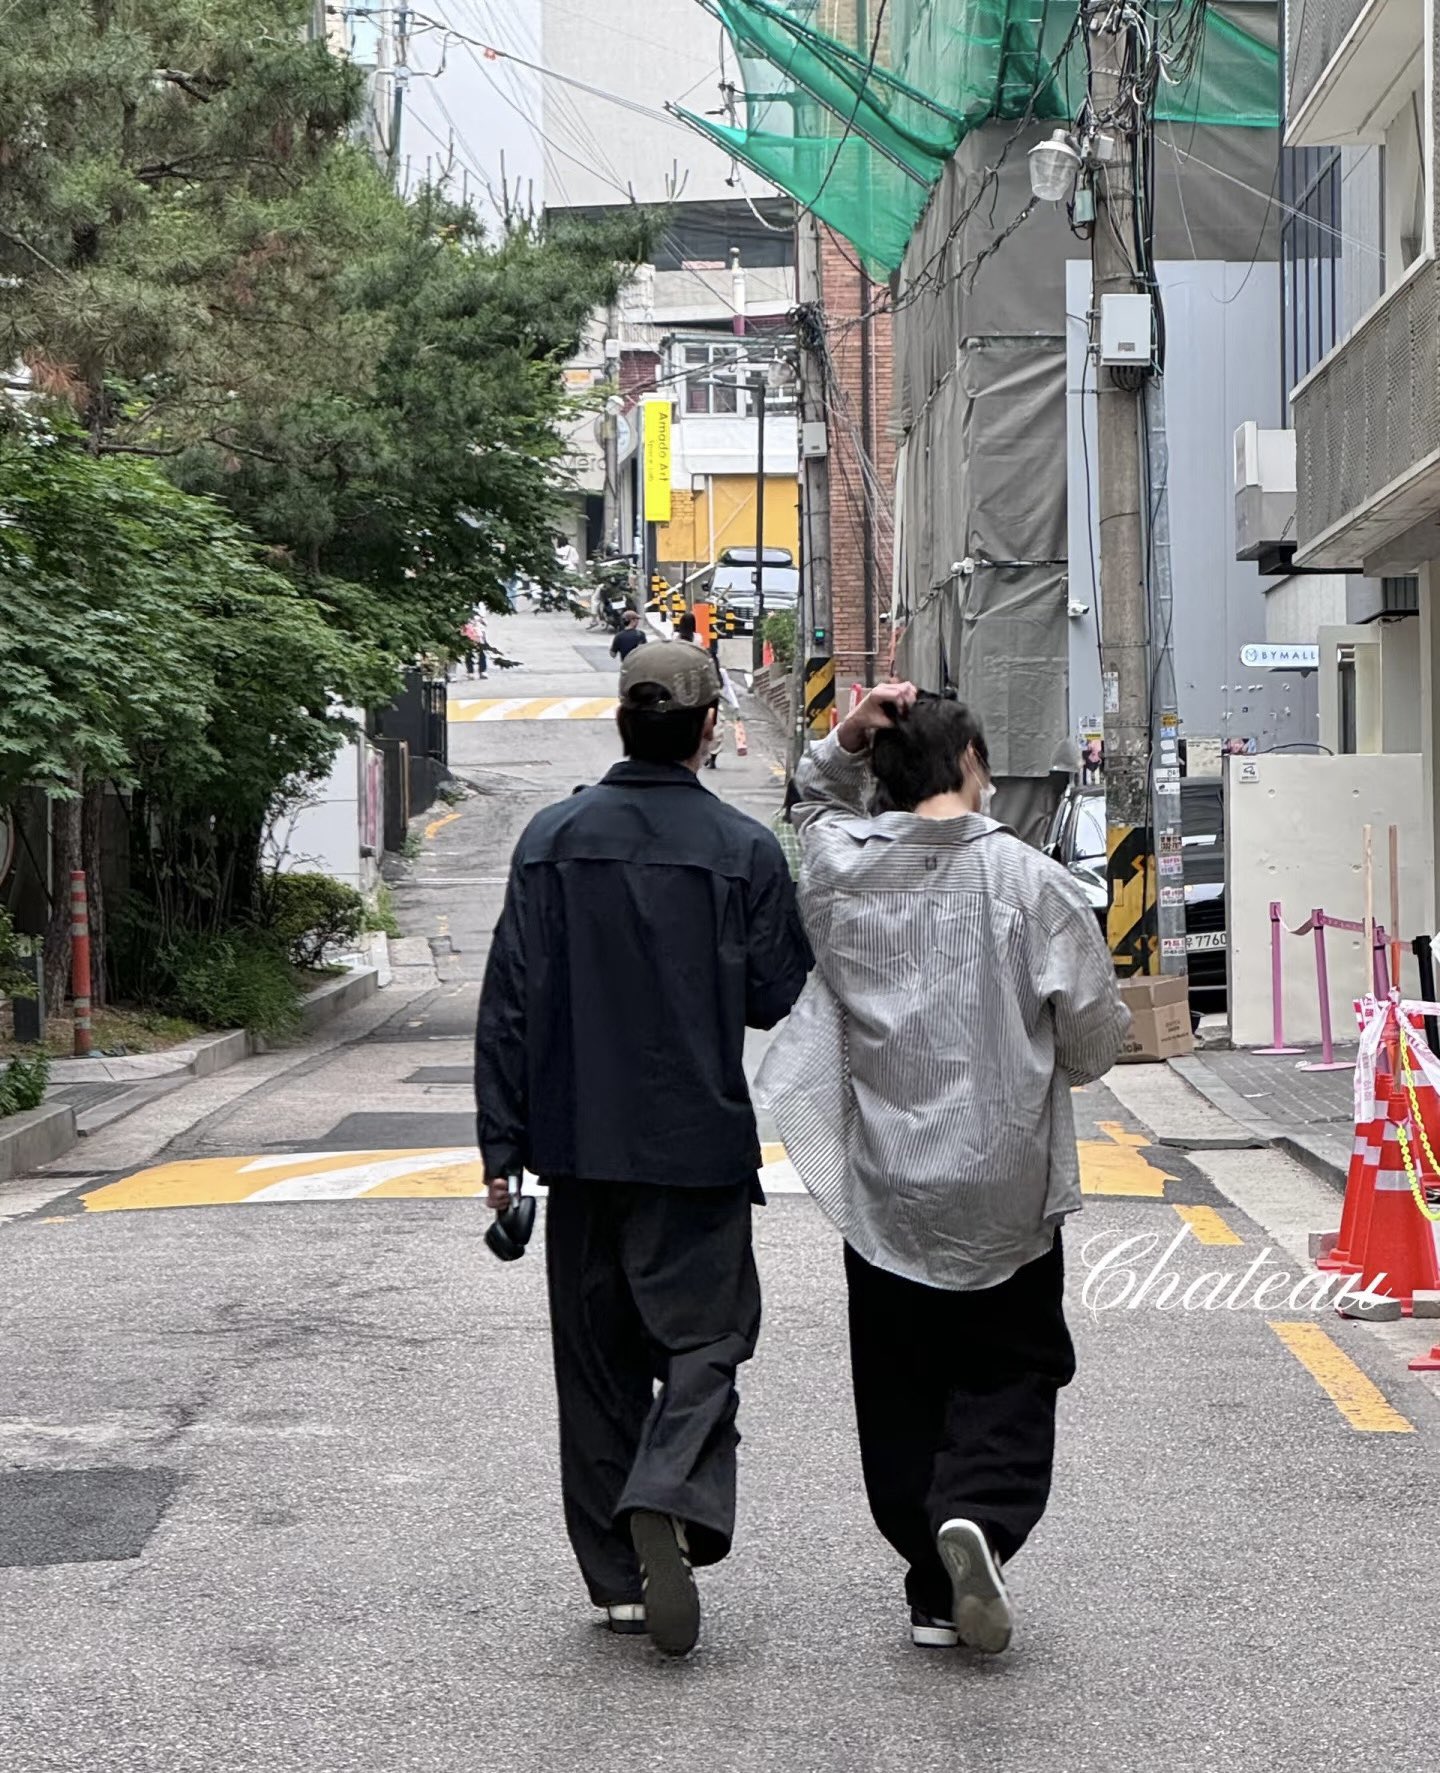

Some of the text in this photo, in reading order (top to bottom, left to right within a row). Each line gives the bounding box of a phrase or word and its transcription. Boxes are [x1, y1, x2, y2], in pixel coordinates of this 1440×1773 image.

[659, 412, 669, 481] Amado Art
[1262, 651, 1315, 660] BYMALL
[1195, 933, 1226, 947] 7760
